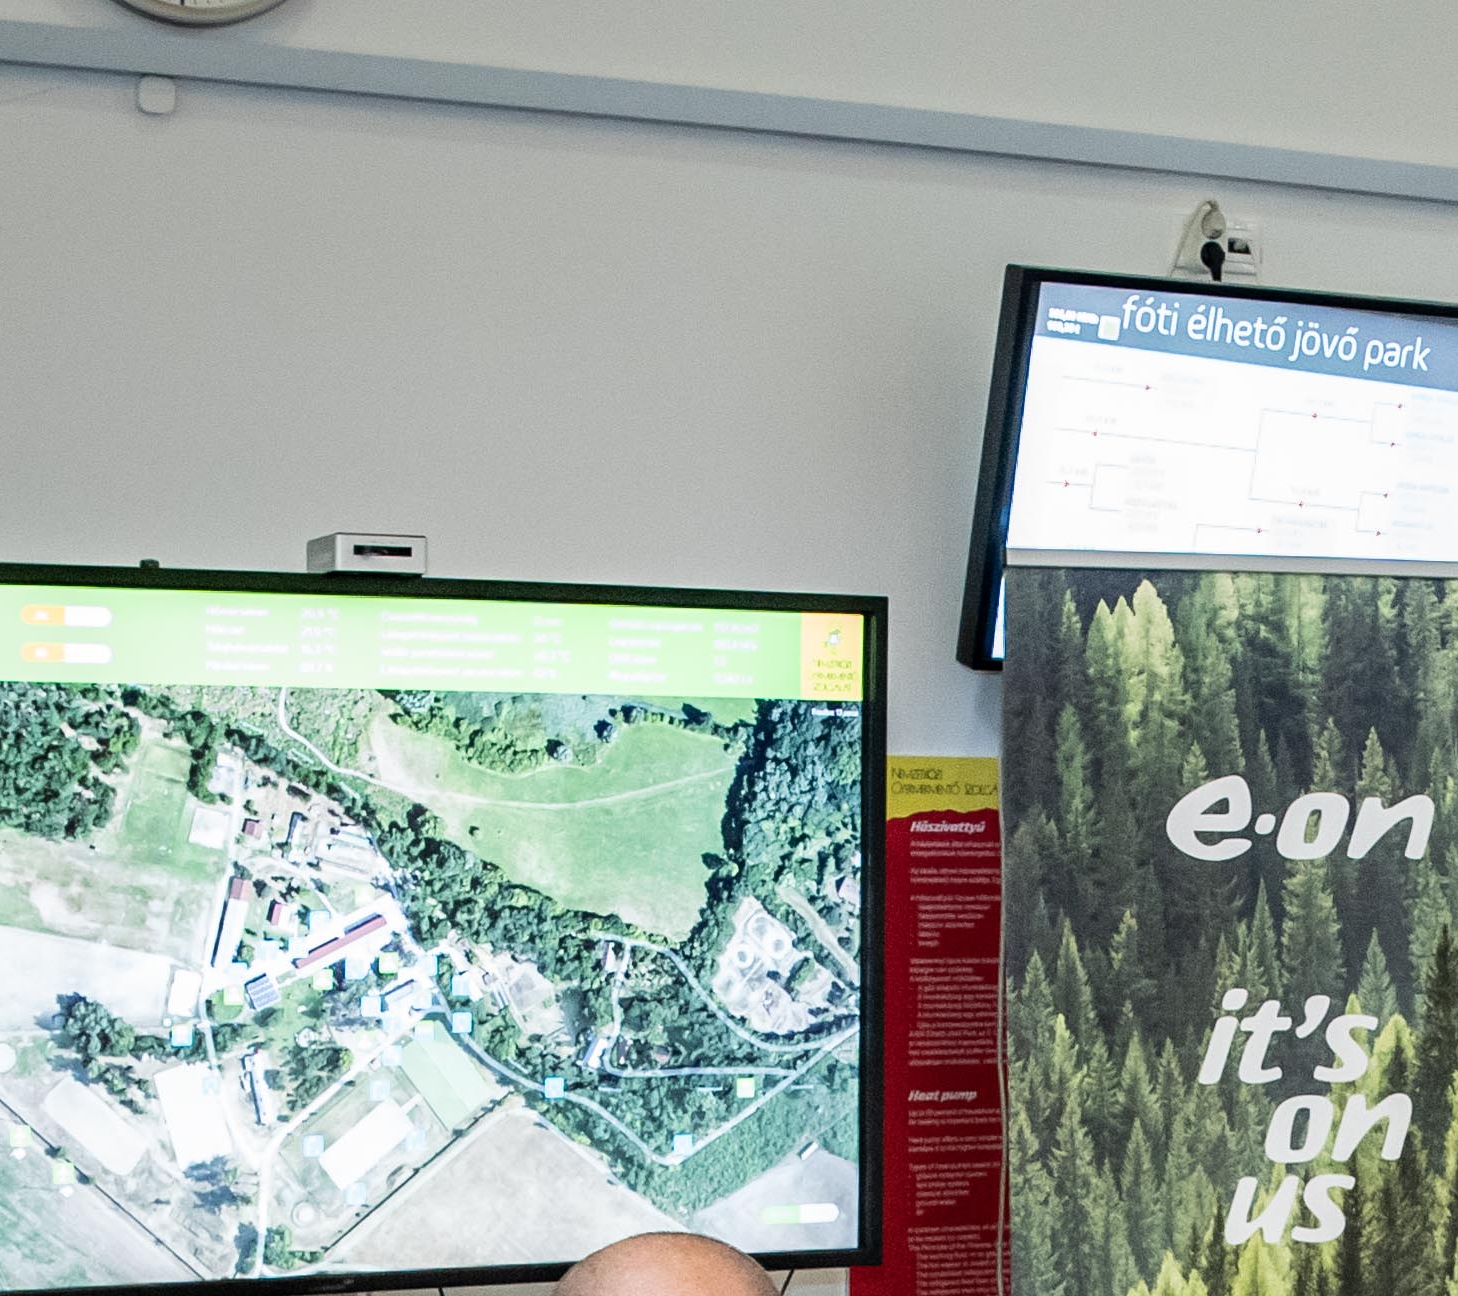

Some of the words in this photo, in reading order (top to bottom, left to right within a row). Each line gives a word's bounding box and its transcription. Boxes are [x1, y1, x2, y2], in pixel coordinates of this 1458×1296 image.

[1122, 294, 1180, 336] fóti
[1187, 305, 1286, 352] élhető
[1289, 320, 1359, 363] jövő
[1363, 335, 1431, 370] park
[1198, 987, 1379, 1085] it's
[908, 1089, 940, 1102] Heat
[941, 1088, 978, 1104] pump
[1264, 1092, 1413, 1164] on
[1223, 1173, 1356, 1246] us
